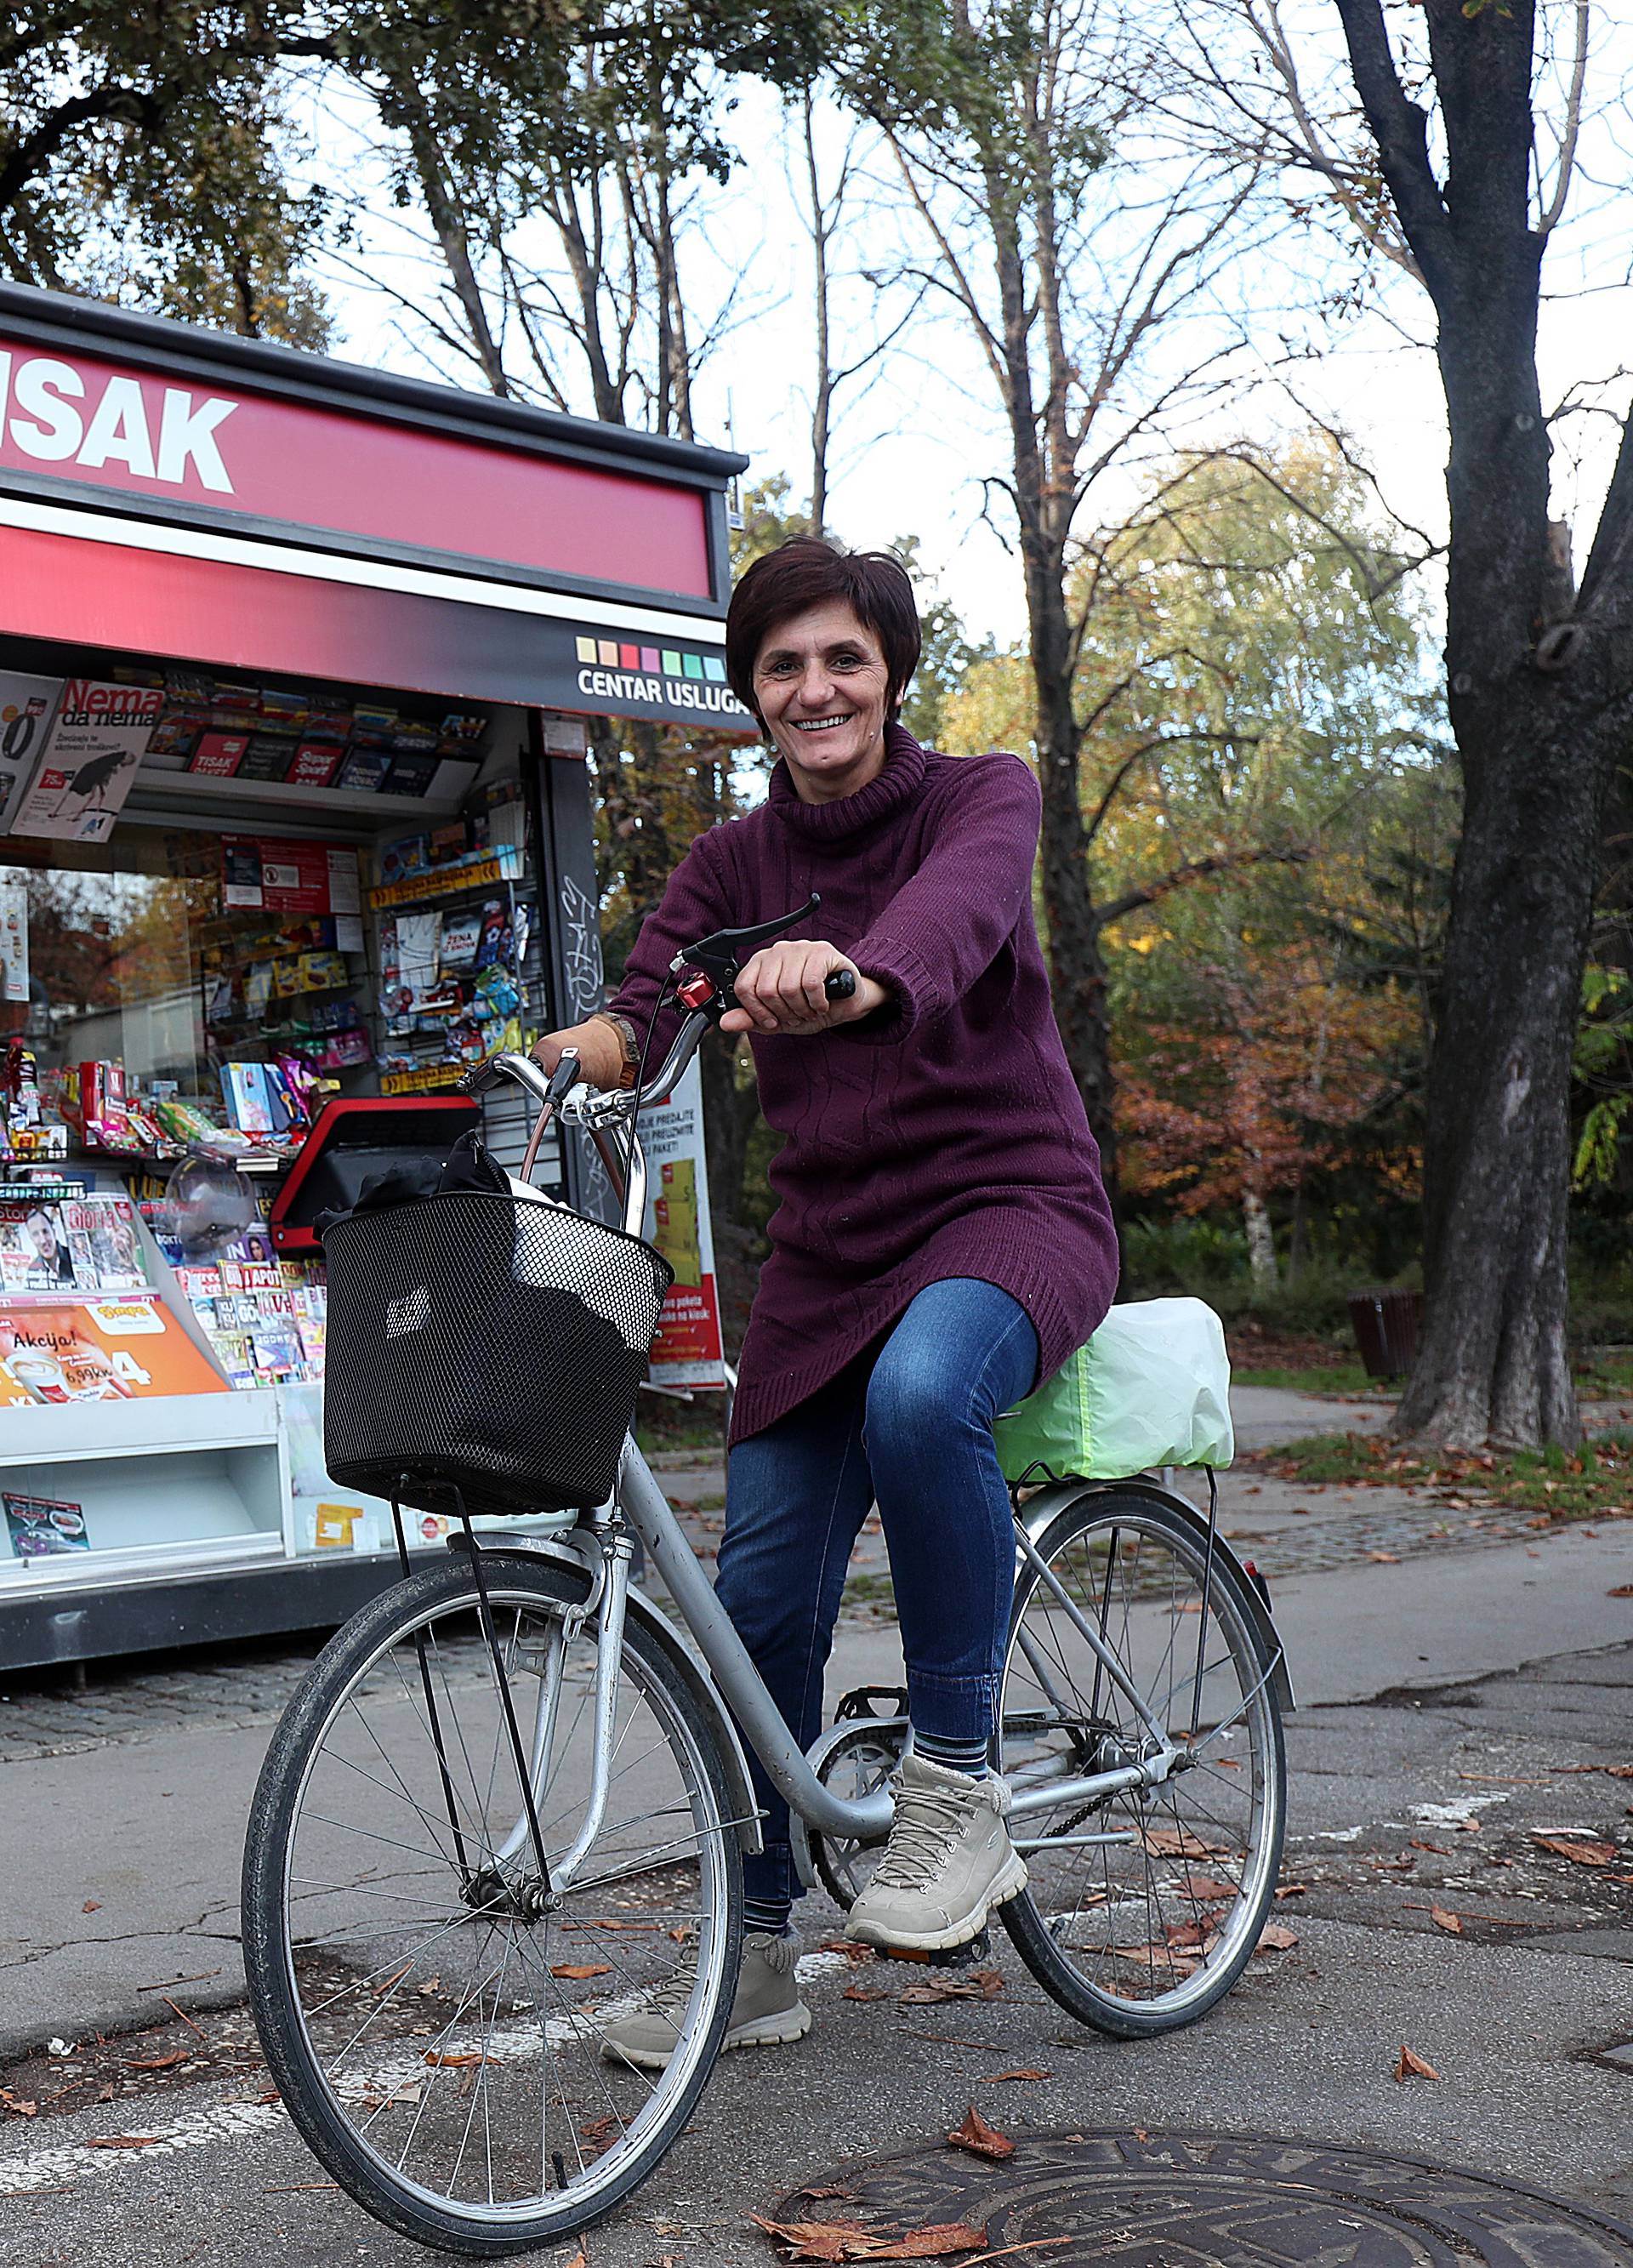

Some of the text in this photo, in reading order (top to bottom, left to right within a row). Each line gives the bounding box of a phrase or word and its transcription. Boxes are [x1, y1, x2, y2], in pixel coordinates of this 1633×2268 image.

[58, 678, 164, 715] Nema
[578, 668, 663, 704] CENTAR
[61, 704, 89, 727] da
[94, 708, 154, 727] nema
[198, 755, 234, 767] TISAK
[68, 1206, 116, 1230] Gloria
[13, 1331, 78, 1351] Akcija!
